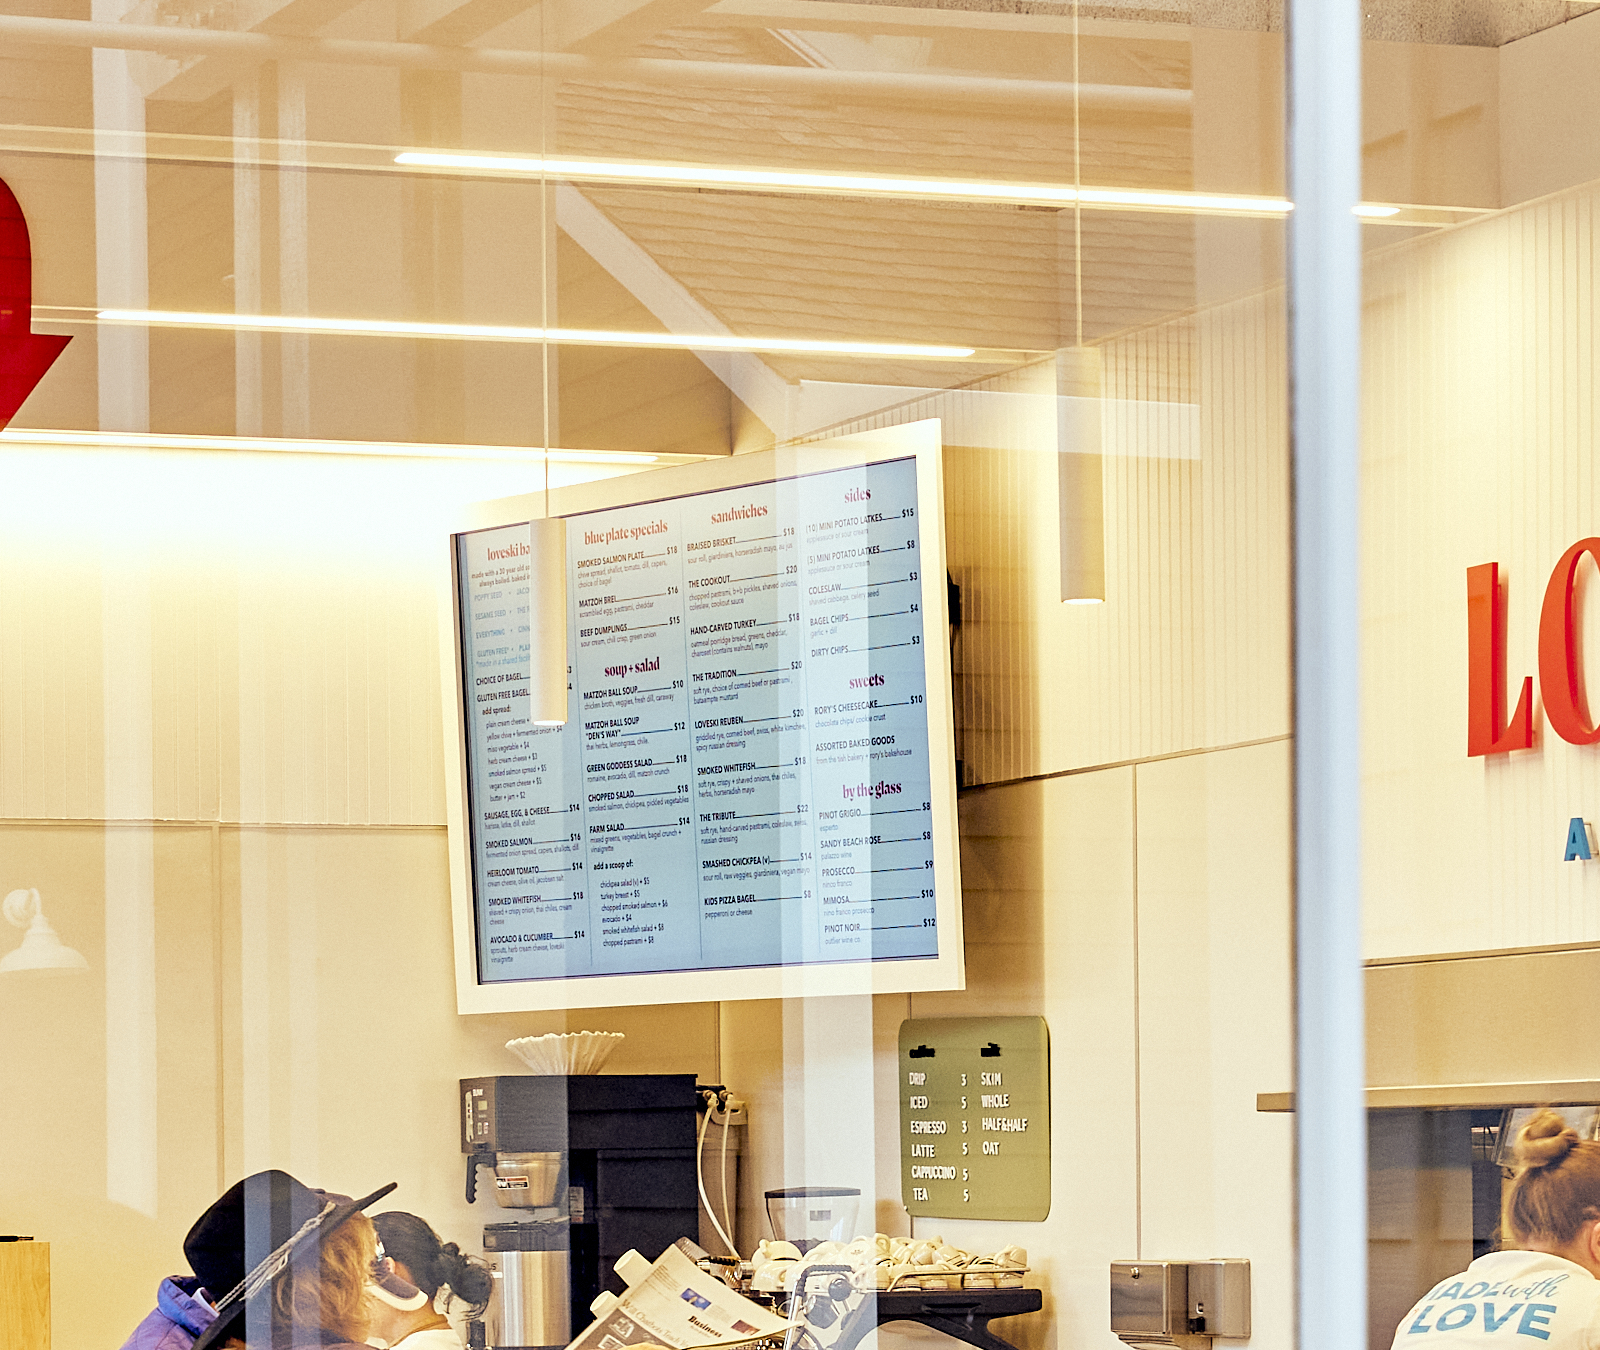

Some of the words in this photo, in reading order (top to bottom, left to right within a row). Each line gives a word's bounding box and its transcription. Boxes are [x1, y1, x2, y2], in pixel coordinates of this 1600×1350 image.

[844, 487, 871, 503] sides
[711, 503, 768, 525] sandwiches
[584, 530, 604, 546] blue
[605, 527, 629, 545] plate
[630, 519, 668, 540] specials
[487, 543, 519, 561] loveski
[688, 580, 699, 589] THE
[700, 575, 731, 587] COOKOUT
[786, 565, 797, 574] $20
[808, 583, 841, 595] COLESLAW
[909, 572, 918, 581] $3
[810, 616, 830, 626] BAGEL
[830, 613, 849, 624] CHIPS
[910, 603, 919, 613] $4
[580, 628, 593, 638] BEEF
[594, 624, 628, 636] DUMPLINGS
[669, 616, 680, 625] $15
[690, 621, 733, 635] HAND-CARVED
[734, 618, 757, 629] TURKEY
[788, 612, 800, 622] $18
[604, 664, 628, 679] soup
[634, 656, 660, 673] salad
[692, 673, 704, 682] THE
[705, 669, 737, 681] TRADITION
[791, 660, 802, 670] $20
[476, 675, 496, 686] CHOICE
[497, 675, 504, 683] OF
[505, 672, 522, 682] BAGEL
[849, 673, 885, 689] sweets
[477, 692, 497, 702] GLUTEN
[498, 690, 510, 700] FREE
[511, 688, 529, 698] BAGEL
[583, 689, 607, 700] MATZOH
[608, 688, 622, 697] BALL
[622, 686, 638, 695] SOUP
[672, 680, 683, 689] $10
[814, 704, 837, 715] RORY'S
[838, 700, 878, 713] CHEESECAKE
[910, 695, 923, 704] $10
[694, 719, 719, 729] LOVESKI
[719, 716, 743, 726] REUBEN
[792, 708, 804, 717] $20
[815, 740, 847, 752] ASSORTED
[849, 738, 870, 748] BAKED
[871, 735, 895, 746] GOODS
[586, 764, 606, 773] GREEN
[606, 760, 633, 771] GODDESS
[634, 758, 652, 768] SALAD
[676, 754, 687, 763] $18
[697, 766, 723, 776] SMOKED
[723, 762, 756, 773] WHITEFISH
[794, 757, 806, 766] $18
[588, 792, 616, 802] CHOPPED
[616, 790, 634, 800] SALAD
[677, 785, 689, 794] $18
[842, 784, 856, 801] by
[857, 783, 874, 797] the
[875, 781, 902, 799] glass
[589, 825, 605, 834] FARM
[606, 823, 624, 832] SALAD
[678, 817, 690, 826] $14
[1564, 817, 1591, 862] A
[486, 868, 515, 878] HEIRLOOM
[516, 866, 539, 876] TOMATO
[572, 862, 583, 871] $14
[822, 867, 855, 877] PROSECCO
[925, 860, 934, 869] $9
[823, 896, 850, 905] MIMOSA
[921, 889, 934, 899] $10
[909, 1072, 926, 1086] DRIP
[961, 1074, 967, 1086] 3
[981, 1072, 1002, 1086] SKIM
[910, 1096, 929, 1109] ICED
[961, 1097, 967, 1109] 5
[981, 1094, 1010, 1108] WHOLE
[910, 1121, 947, 1134] ESPRESSO
[962, 1121, 968, 1133] 3
[982, 1118, 1028, 1132] HALF&HALF
[911, 1144, 936, 1158] LATTE
[962, 1142, 969, 1155] 5
[982, 1141, 1000, 1155] OAT
[911, 1165, 957, 1180] CAPPUCCINO
[963, 1168, 969, 1181] 5
[913, 1188, 928, 1201] TEA
[964, 1189, 970, 1202] 5
[1502, 1274, 1569, 1300] with
[687, 1315, 723, 1338] Business
[1407, 1302, 1557, 1340] LOVE
